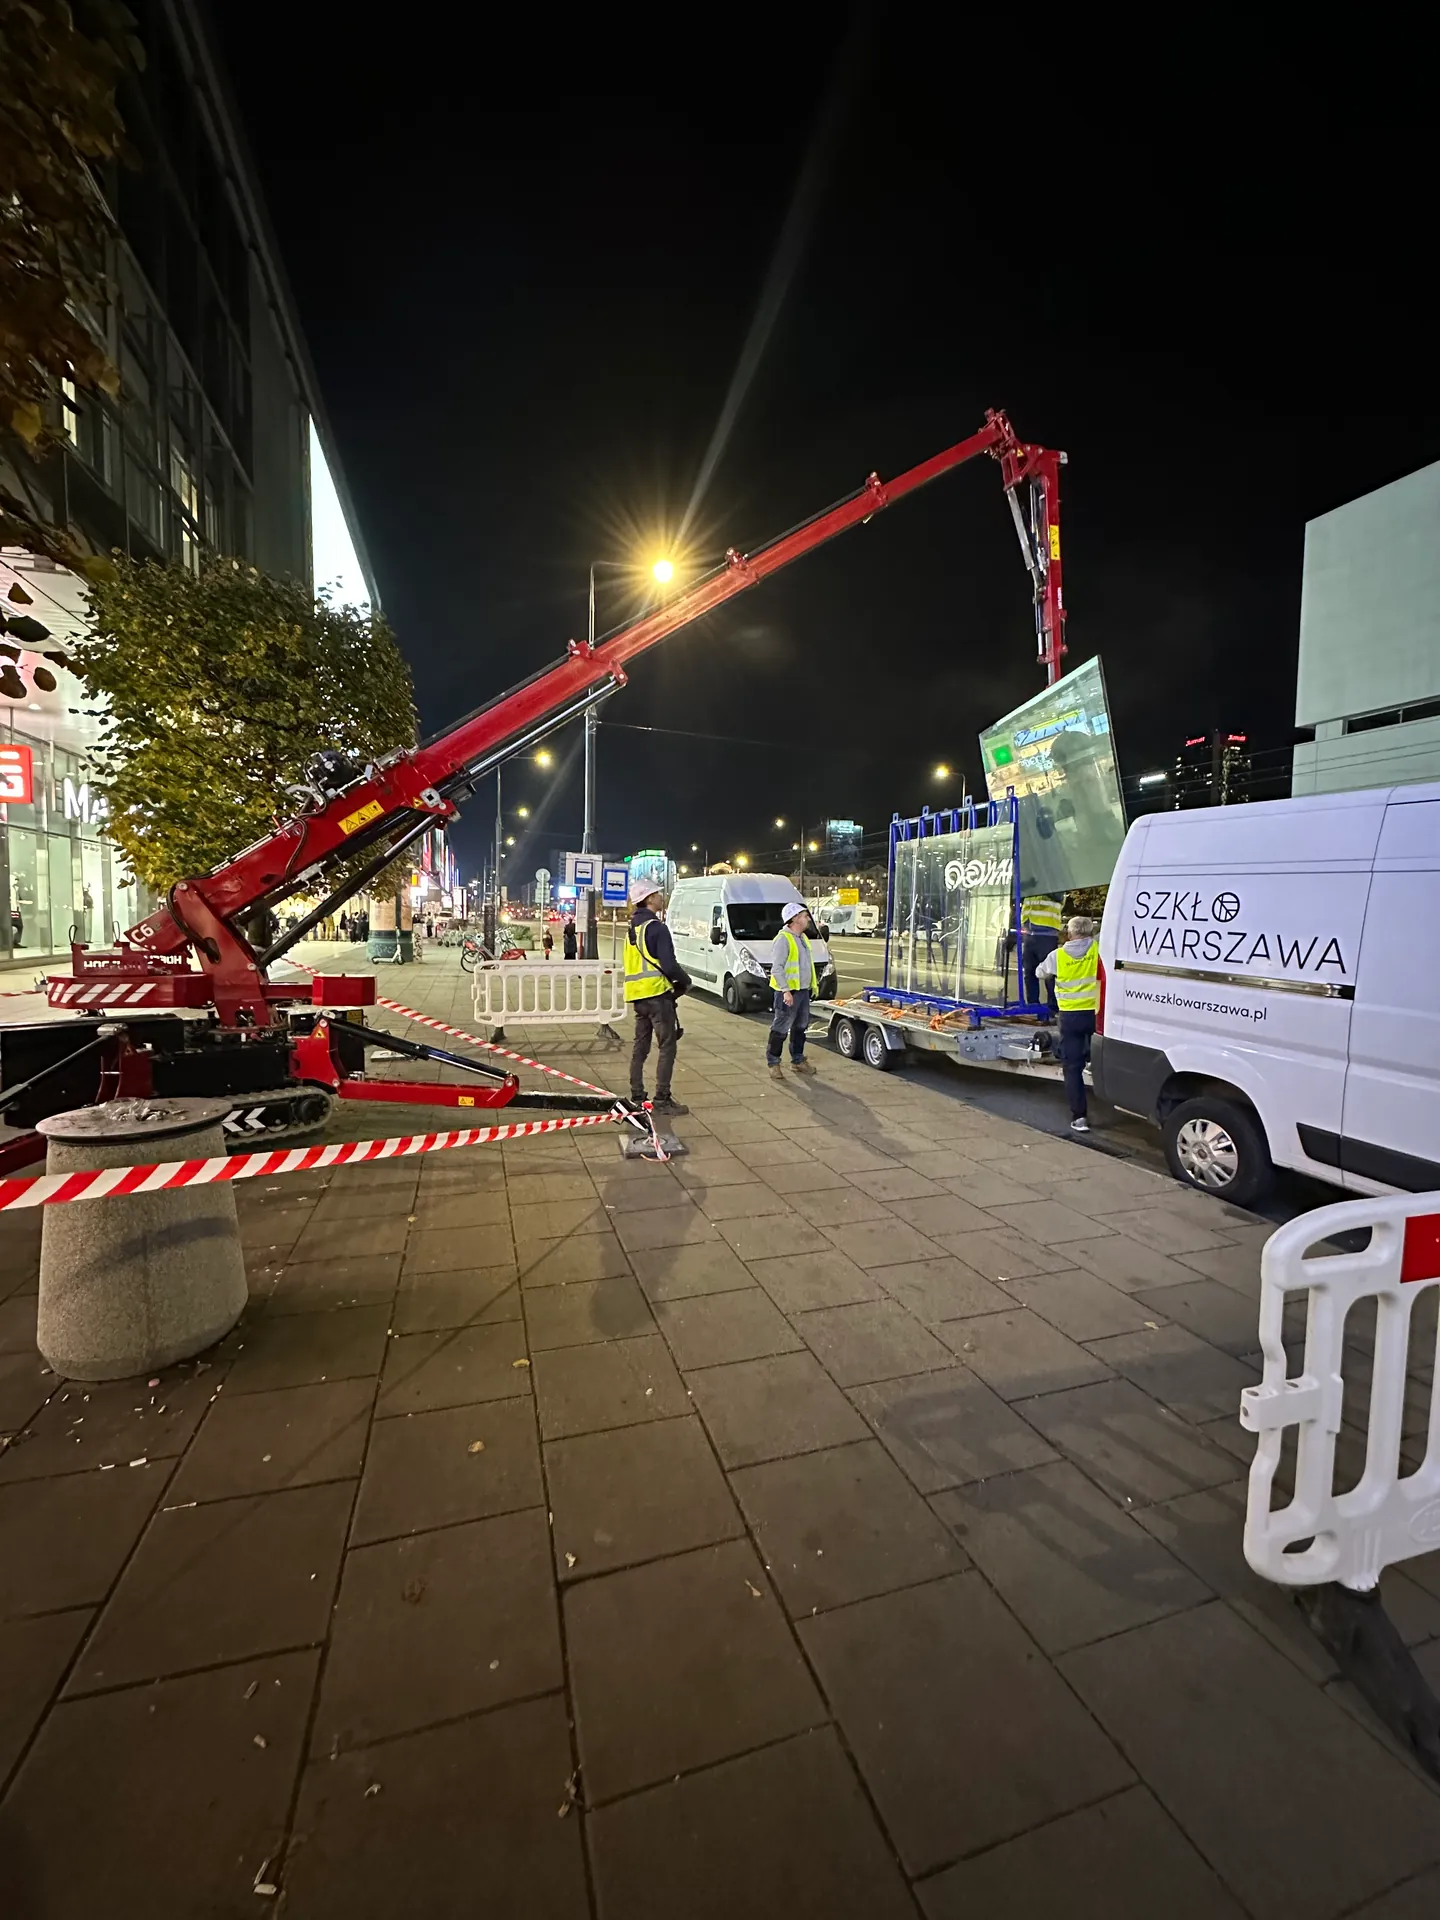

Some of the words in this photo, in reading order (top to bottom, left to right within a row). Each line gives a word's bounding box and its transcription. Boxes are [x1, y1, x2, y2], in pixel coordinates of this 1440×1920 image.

[1133, 891, 1241, 923] SZKŁO
[1131, 925, 1347, 974] WARSZAWA
[1125, 987, 1268, 1023] www.szklowarszawa.pl
